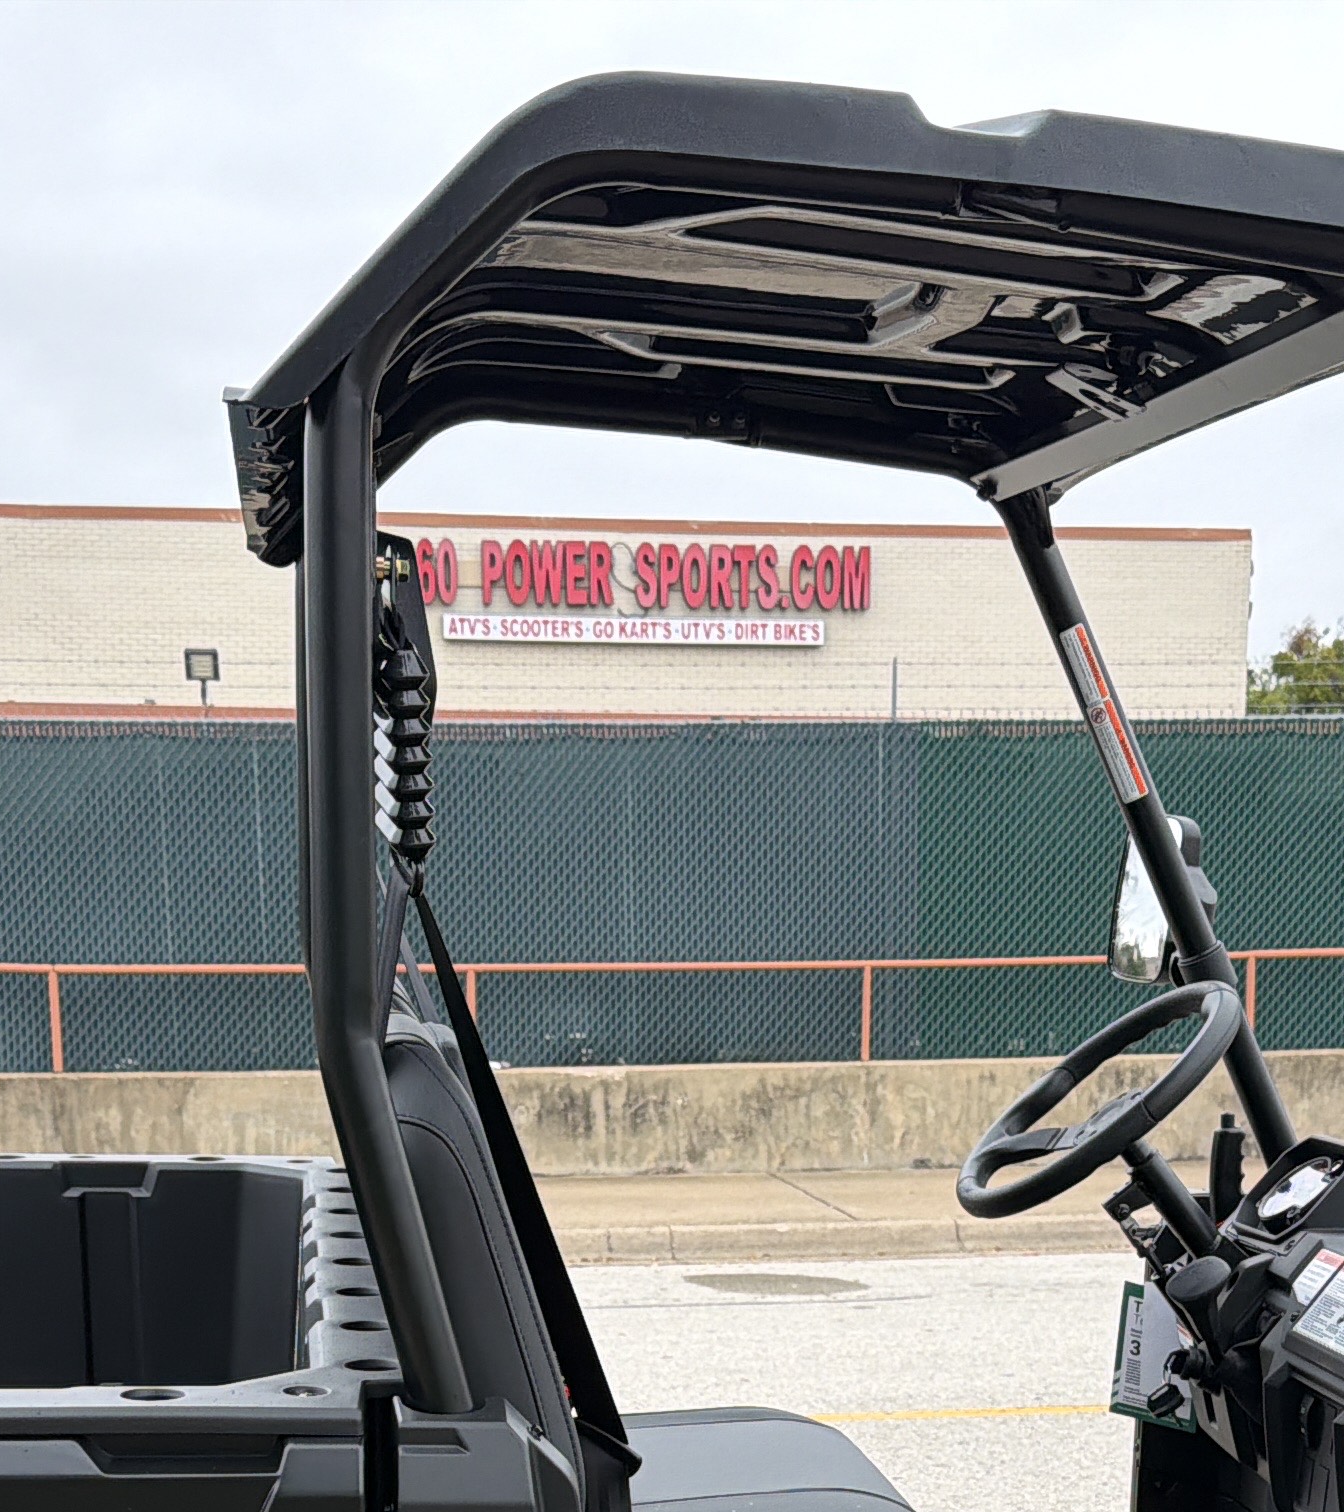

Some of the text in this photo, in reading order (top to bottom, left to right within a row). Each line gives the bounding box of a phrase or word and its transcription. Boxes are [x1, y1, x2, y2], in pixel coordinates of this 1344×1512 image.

[481, 539, 614, 607] POWER
[634, 542, 872, 611] SPORTS.COM
[448, 617, 820, 642] ATV'S SCOOTER'S GO KART'S UTV'S DIRT BIKE'S
